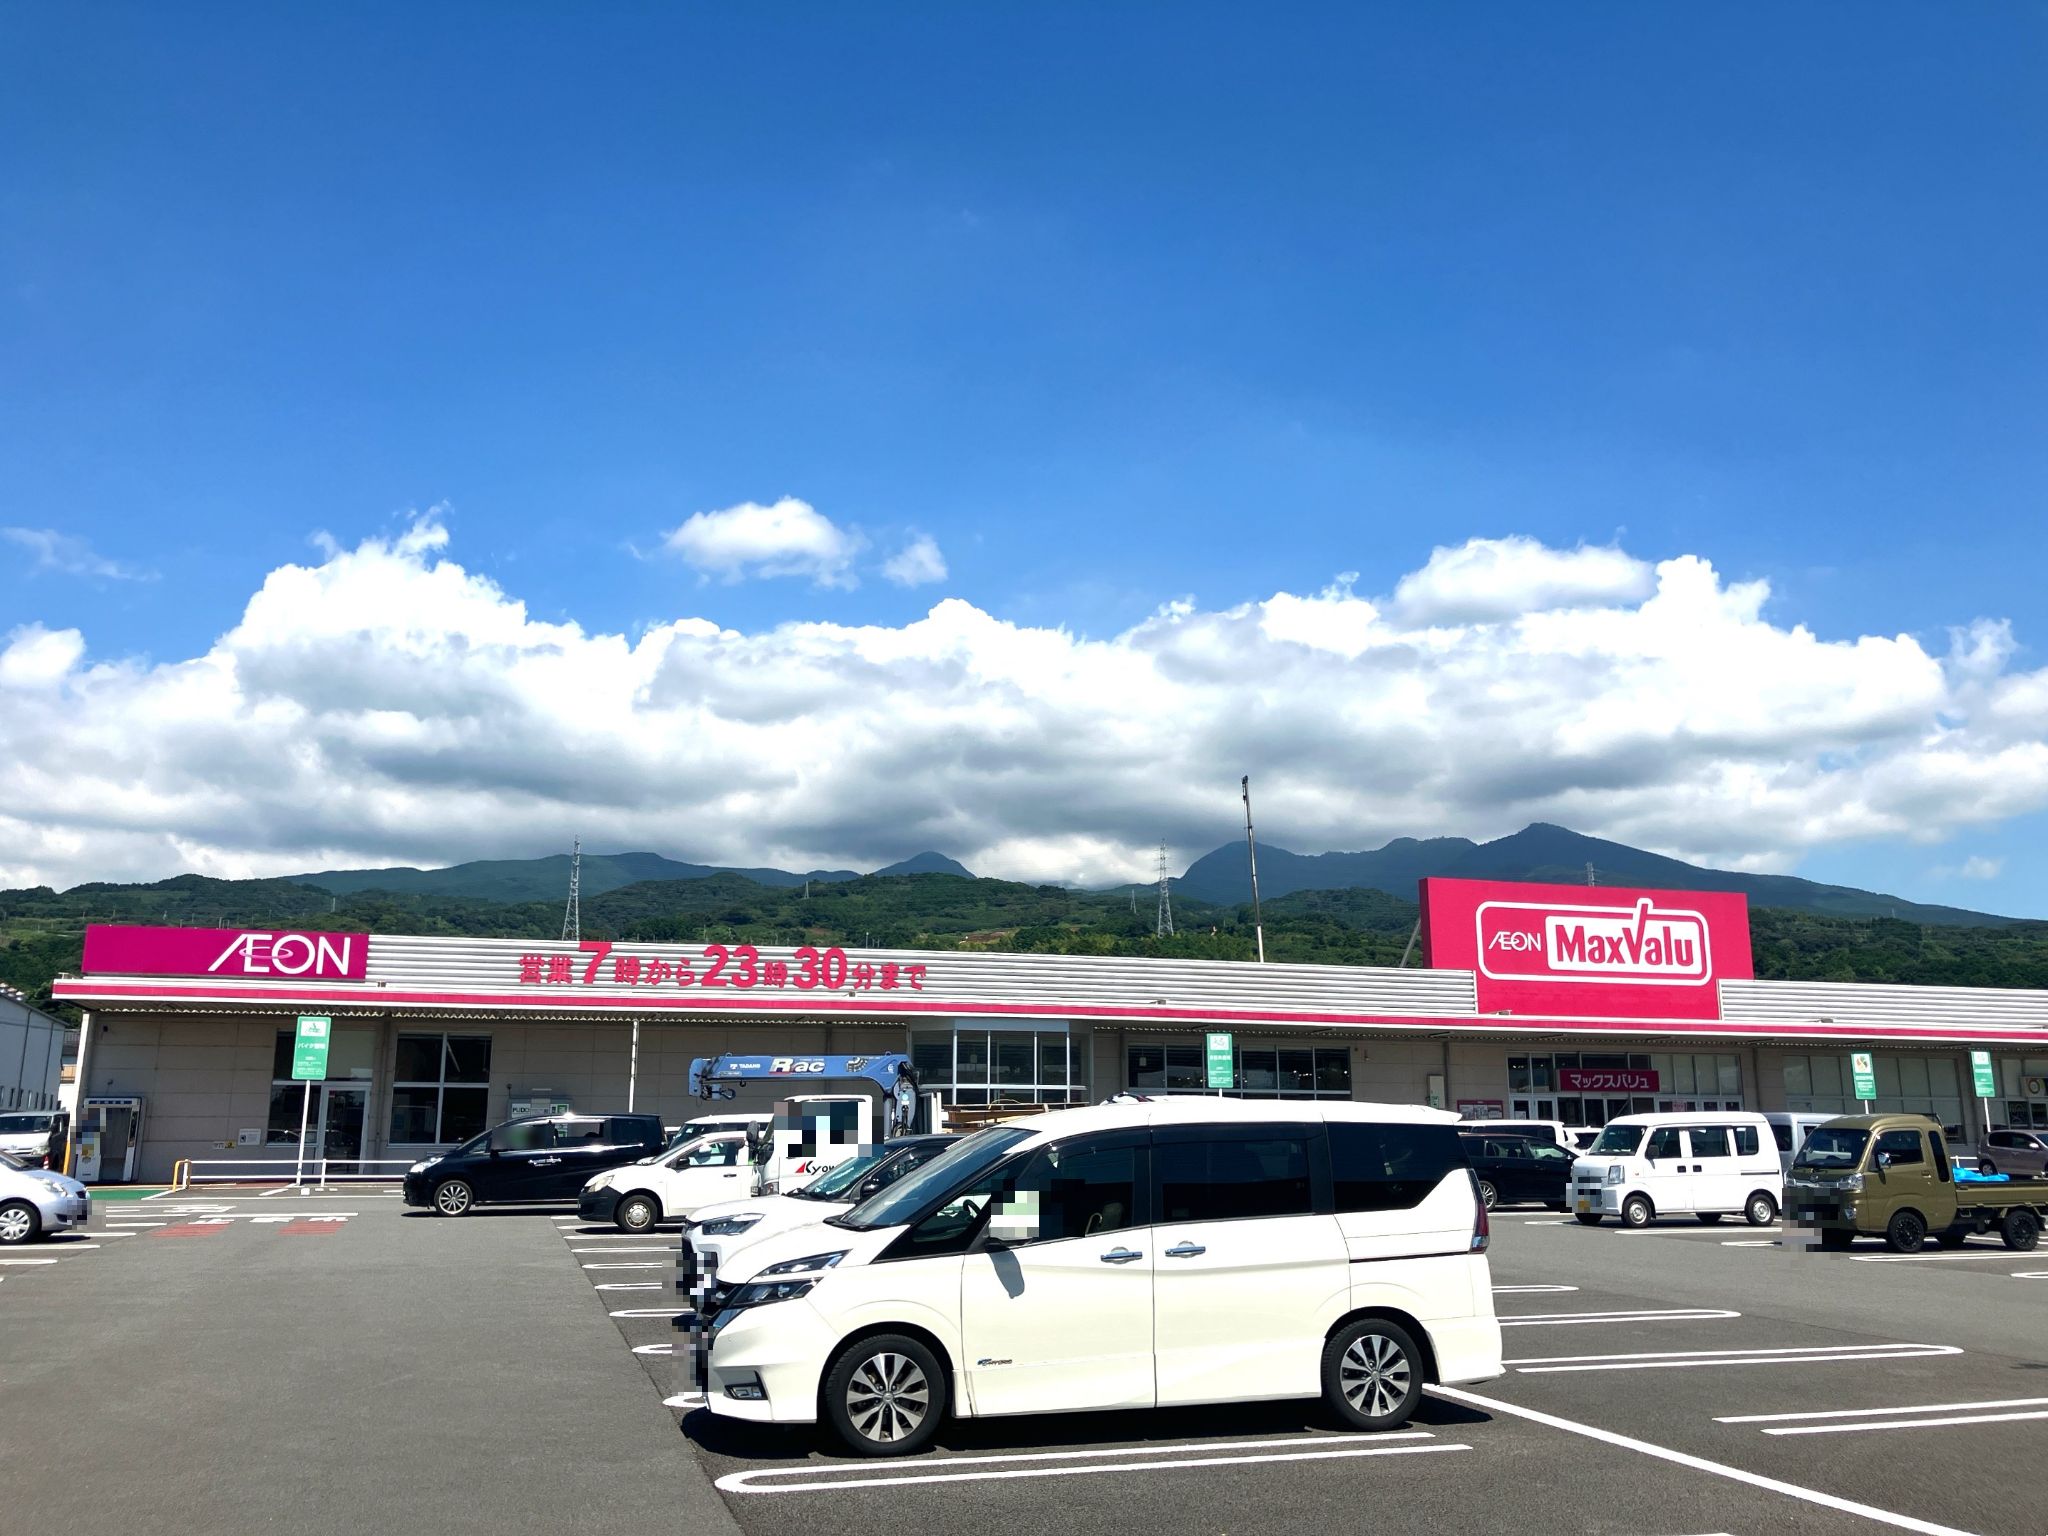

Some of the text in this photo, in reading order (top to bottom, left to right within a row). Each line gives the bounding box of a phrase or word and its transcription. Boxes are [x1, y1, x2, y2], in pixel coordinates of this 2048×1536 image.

[1555, 903, 1695, 967] MaxValu
[519, 940, 927, 991] 営業7時から23時30分まで
[768, 1057, 826, 1073] Rac
[1569, 1073, 1650, 1090] マックスバリュ
